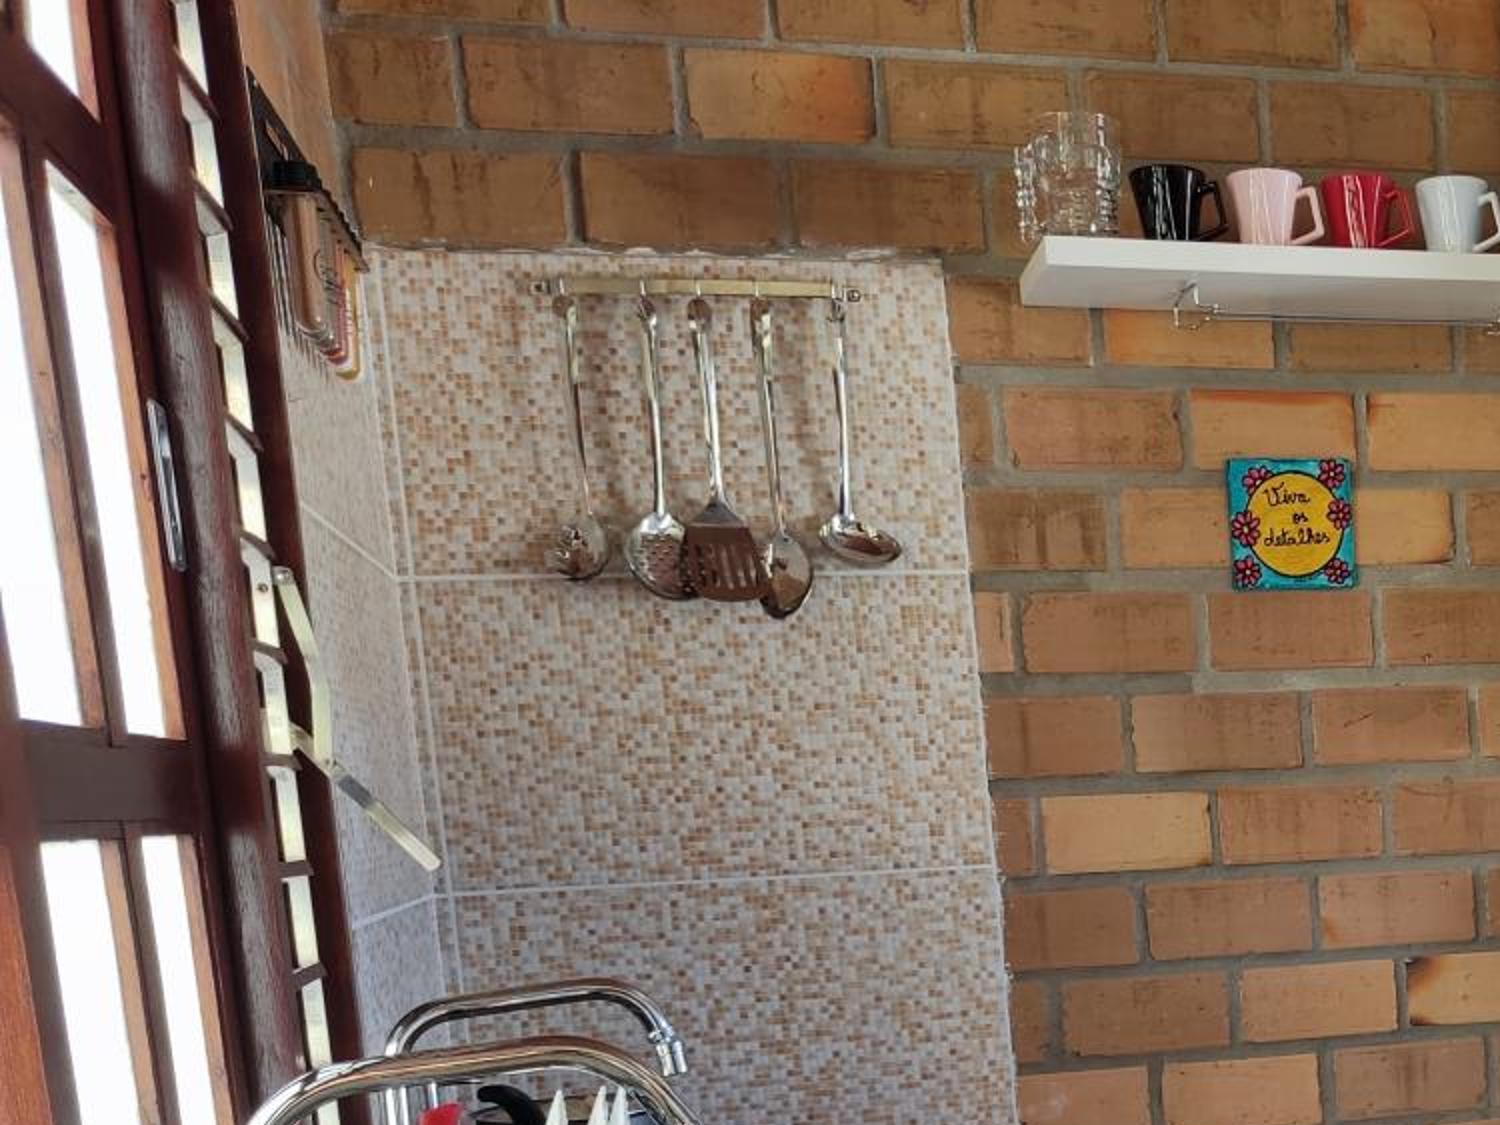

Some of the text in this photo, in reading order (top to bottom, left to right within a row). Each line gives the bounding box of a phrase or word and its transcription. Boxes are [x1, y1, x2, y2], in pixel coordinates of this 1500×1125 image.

[1265, 483, 1310, 506] Viva
[1292, 512, 1309, 525] os
[1264, 527, 1330, 546] detalhes
